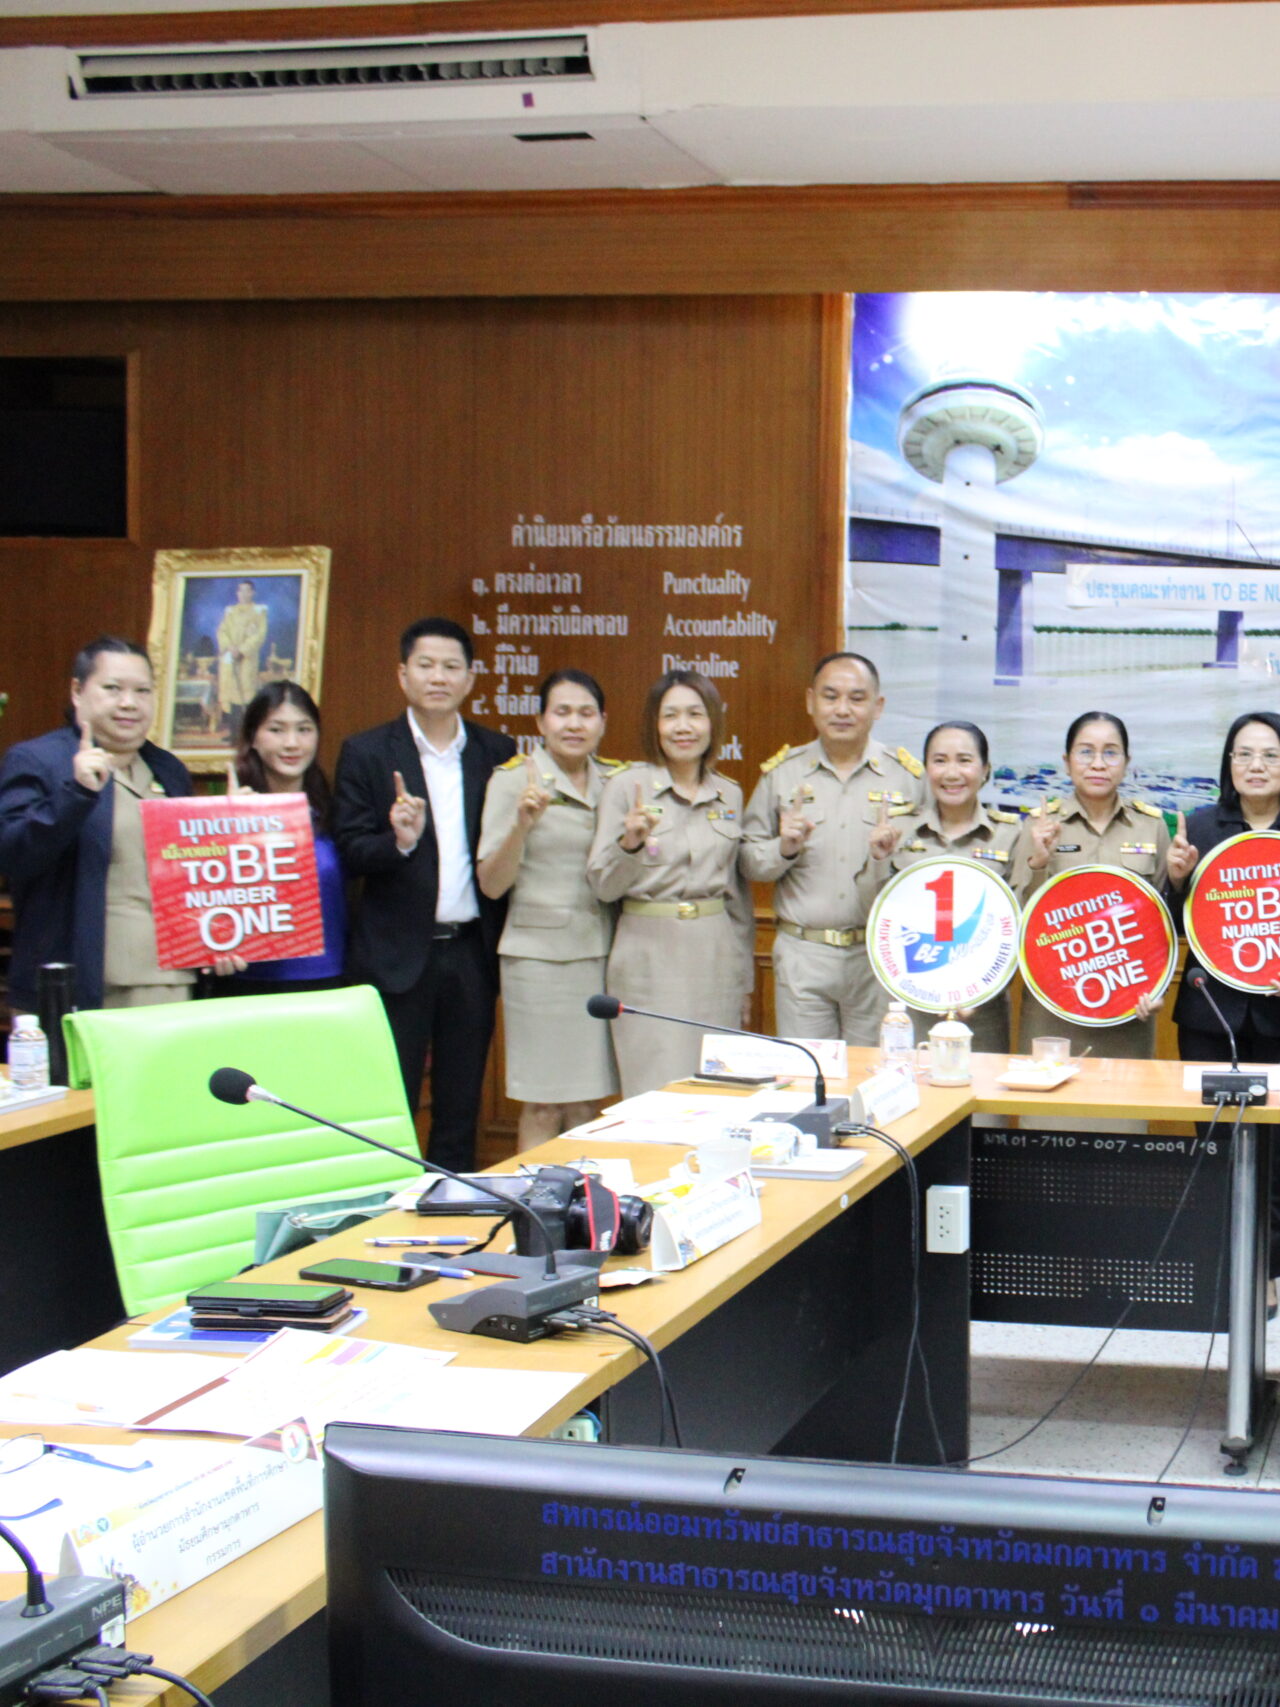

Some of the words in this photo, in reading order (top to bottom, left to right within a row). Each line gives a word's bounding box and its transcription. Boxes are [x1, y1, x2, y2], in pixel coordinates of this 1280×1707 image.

[511, 512, 743, 548] ค่านิยมหรือวัฒนธรรมองค์กร
[494, 562, 582, 594] ตรงต่อเวลา
[663, 569, 750, 602] Punctuality
[1212, 582, 1232, 601] TO
[1239, 583, 1258, 602] BE
[496, 603, 628, 636] มีความรับผิดชอบ
[663, 611, 778, 645] Accountability
[494, 643, 540, 676] มีวินัย
[178, 815, 285, 844] มุกดาหาร
[180, 859, 227, 885] TO
[228, 841, 301, 884] BE
[184, 885, 278, 909] NUMBER
[925, 870, 954, 942] 1
[1044, 890, 1123, 929] มุกดาหาร
[1220, 900, 1253, 921] TO
[200, 903, 295, 952] ONE
[1052, 938, 1087, 962] TO
[1084, 909, 1144, 954] BE
[913, 943, 944, 963] BE
[947, 990, 961, 1002] TO
[966, 983, 980, 997] BE
[981, 943, 1012, 985] NUMBER
[999, 915, 1013, 936] ONE
[1059, 948, 1129, 980] NUMBER
[1075, 959, 1148, 1008] ONE
[1183, 1541, 1259, 1580] จำกัด
[1059, 1579, 1125, 1620] วันที่
[1174, 1590, 1279, 1630] มีนาคม
